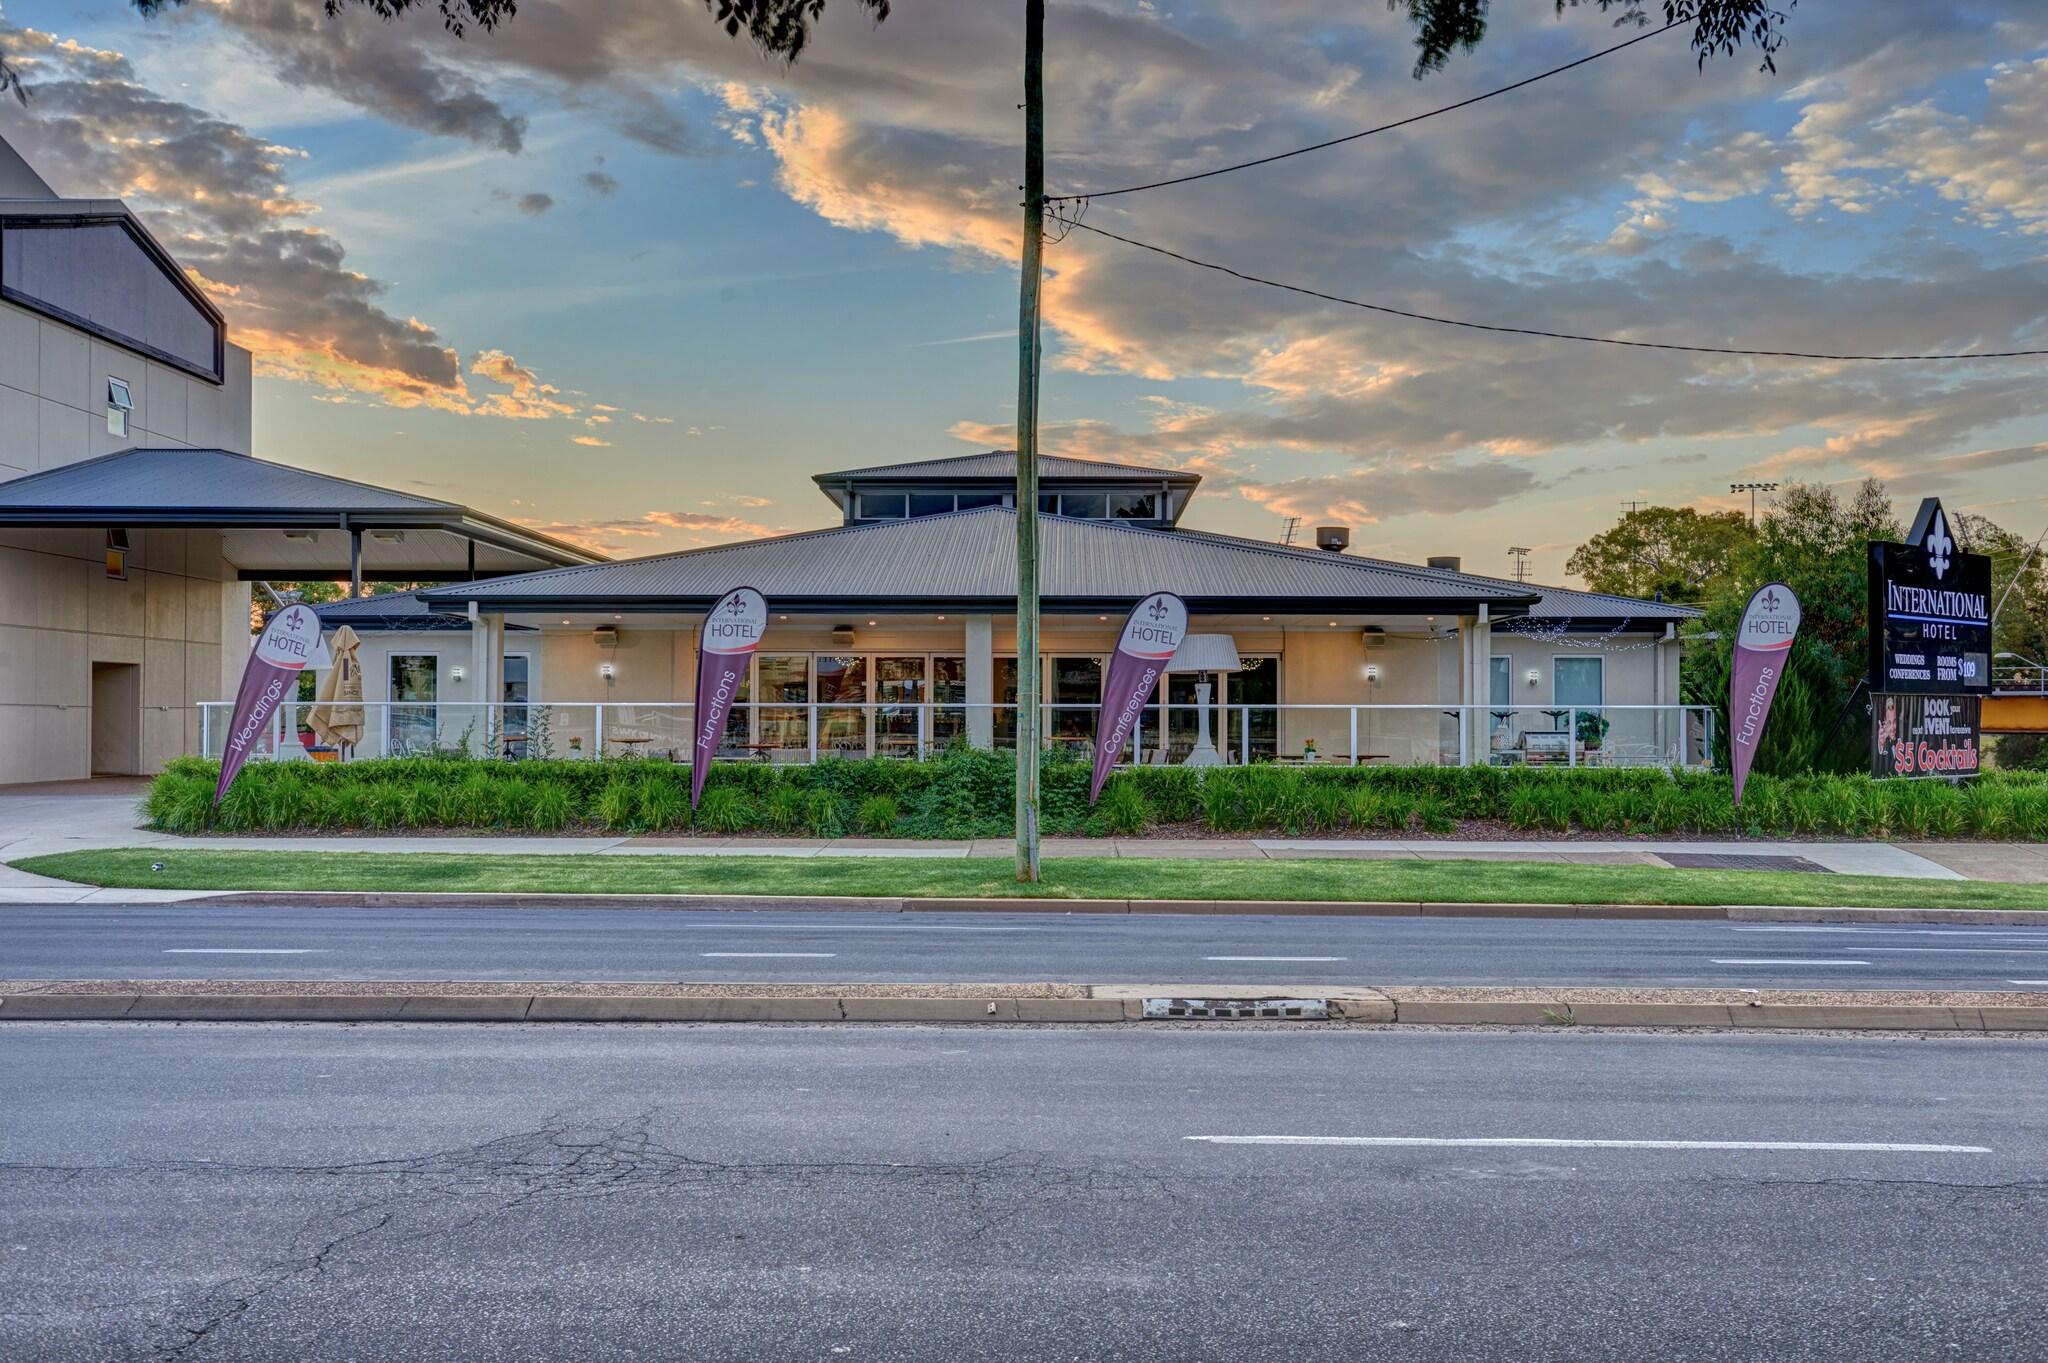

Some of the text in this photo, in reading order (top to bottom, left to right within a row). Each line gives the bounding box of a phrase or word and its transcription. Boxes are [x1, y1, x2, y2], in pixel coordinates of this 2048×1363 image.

[1887, 579, 1988, 619] INTERNATIONAL
[711, 624, 757, 639] HOTEL
[1133, 619, 1178, 631] INTERNATIONAL
[1748, 620, 1792, 634] HOTEL
[1922, 623, 1957, 640] HOTEL
[1131, 626, 1176, 646] HOTEL
[268, 634, 308, 658] HOTEL
[1894, 653, 1926, 666] WEDDINGS
[1937, 655, 1957, 667] ROOMS
[1958, 658, 1976, 678] $109
[1889, 668, 1931, 680] CONFERENCES
[1937, 668, 1957, 680] FROM
[230, 679, 283, 752] Weddings
[697, 670, 736, 749] Functions
[1104, 667, 1157, 754] Conferences
[1736, 666, 1774, 746] Functions
[1924, 697, 1950, 716] BOOK
[1895, 738, 1978, 775] $5 Cocktails
